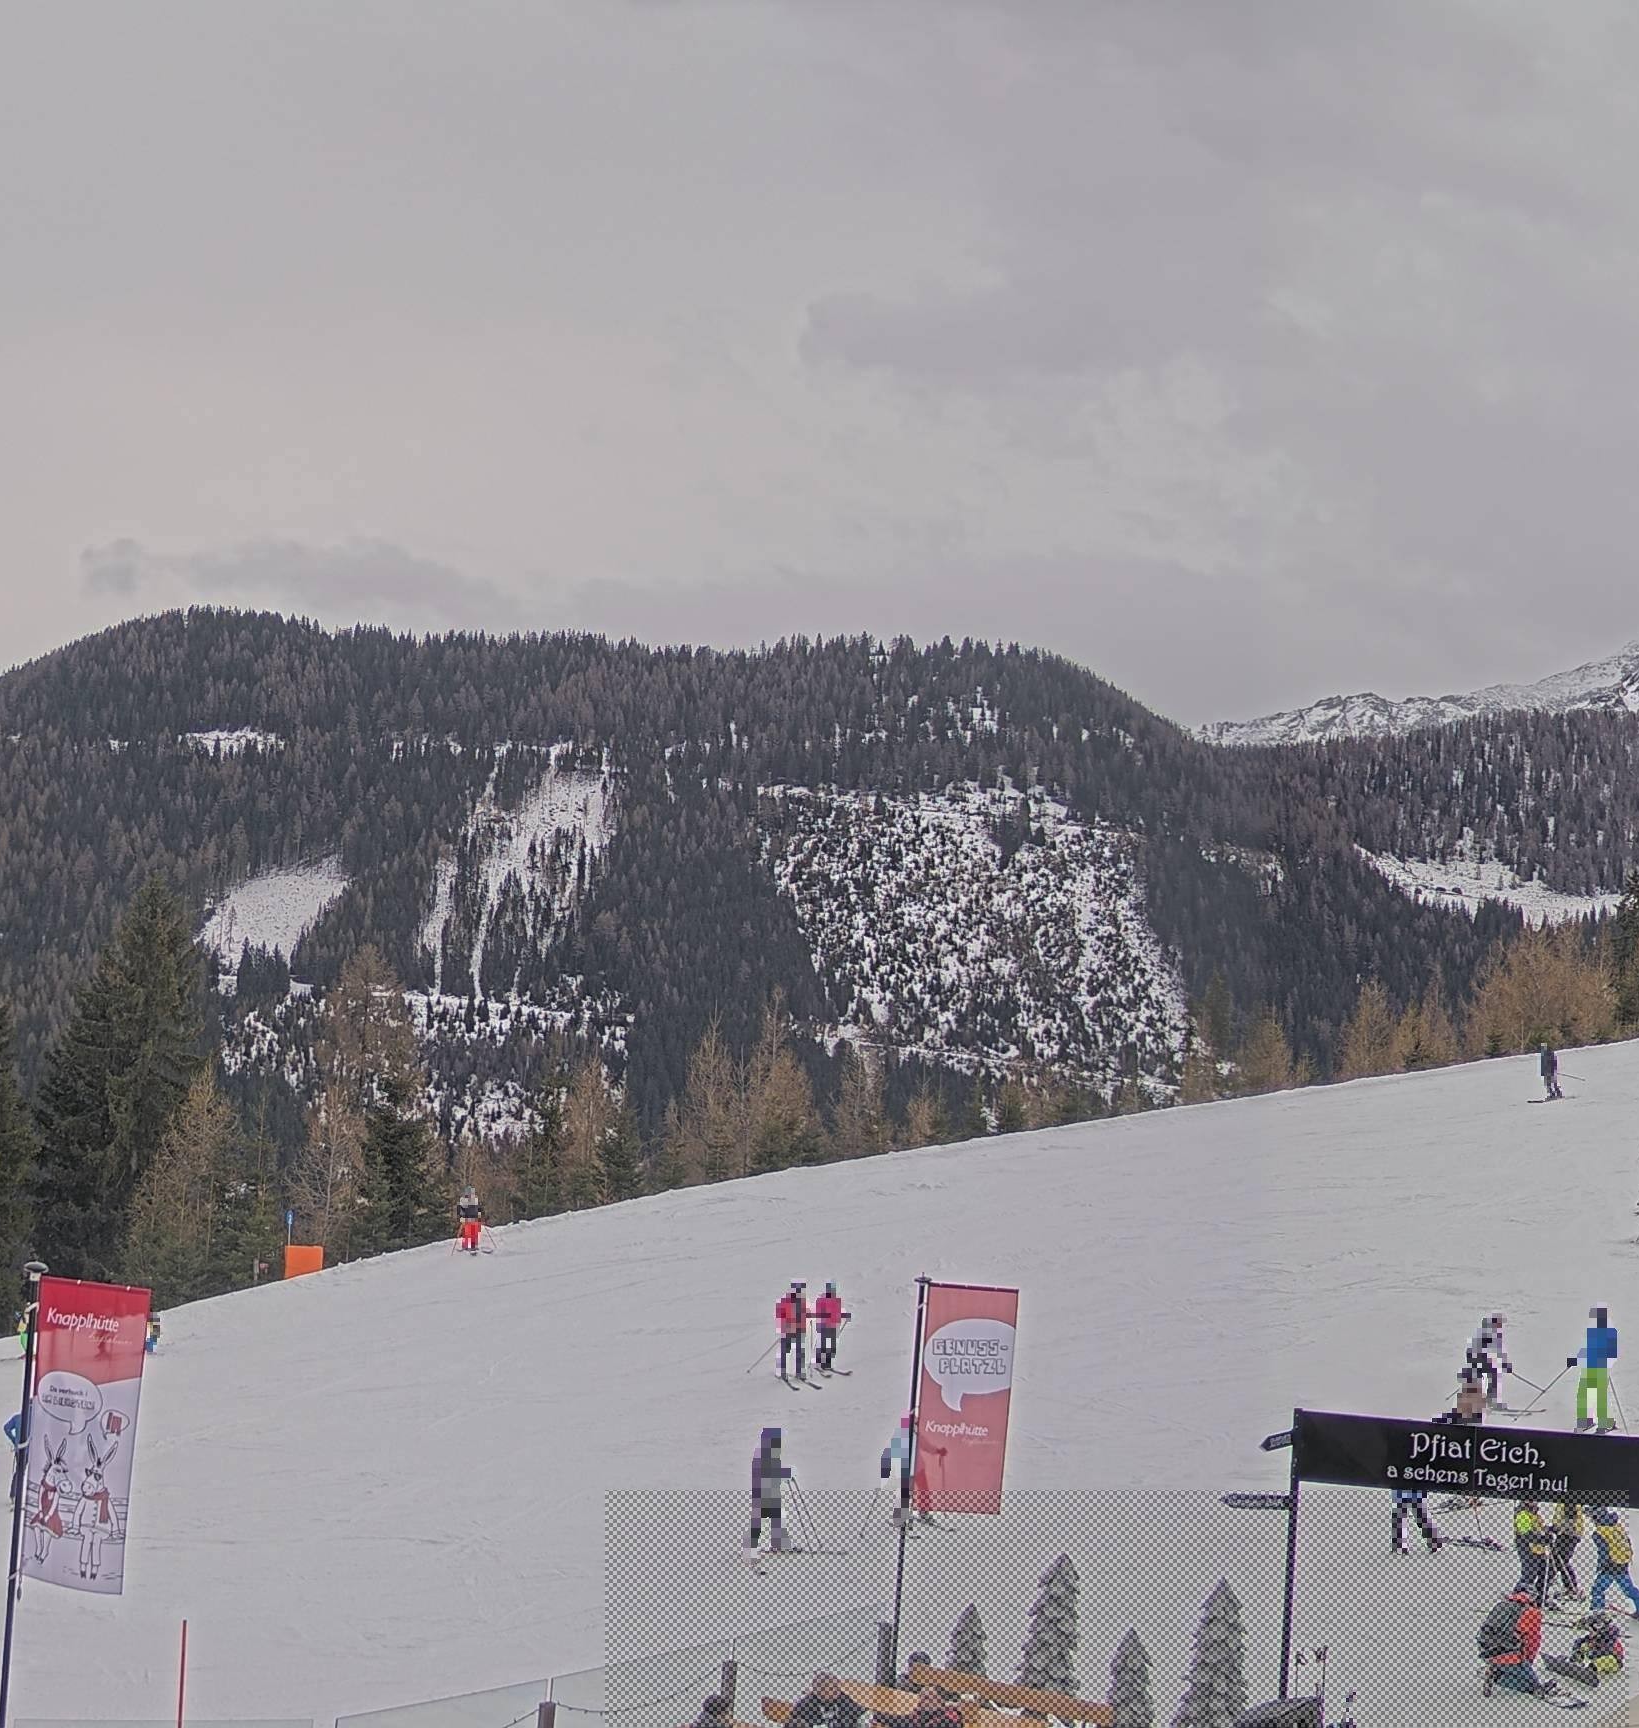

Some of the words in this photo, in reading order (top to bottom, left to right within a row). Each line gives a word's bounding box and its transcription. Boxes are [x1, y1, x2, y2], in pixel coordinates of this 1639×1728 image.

[46, 1307, 120, 1332] Knapplhütte
[932, 1338, 1009, 1357] GENUSS-
[939, 1358, 1006, 1375] PLATZL
[1410, 1432, 1472, 1462] Pfiat
[1480, 1438, 1547, 1469] Eich,
[1387, 1465, 1398, 1478] a
[1403, 1465, 1469, 1485] schens
[1474, 1469, 1534, 1492] Tagerl
[1539, 1475, 1569, 1493] nu!
